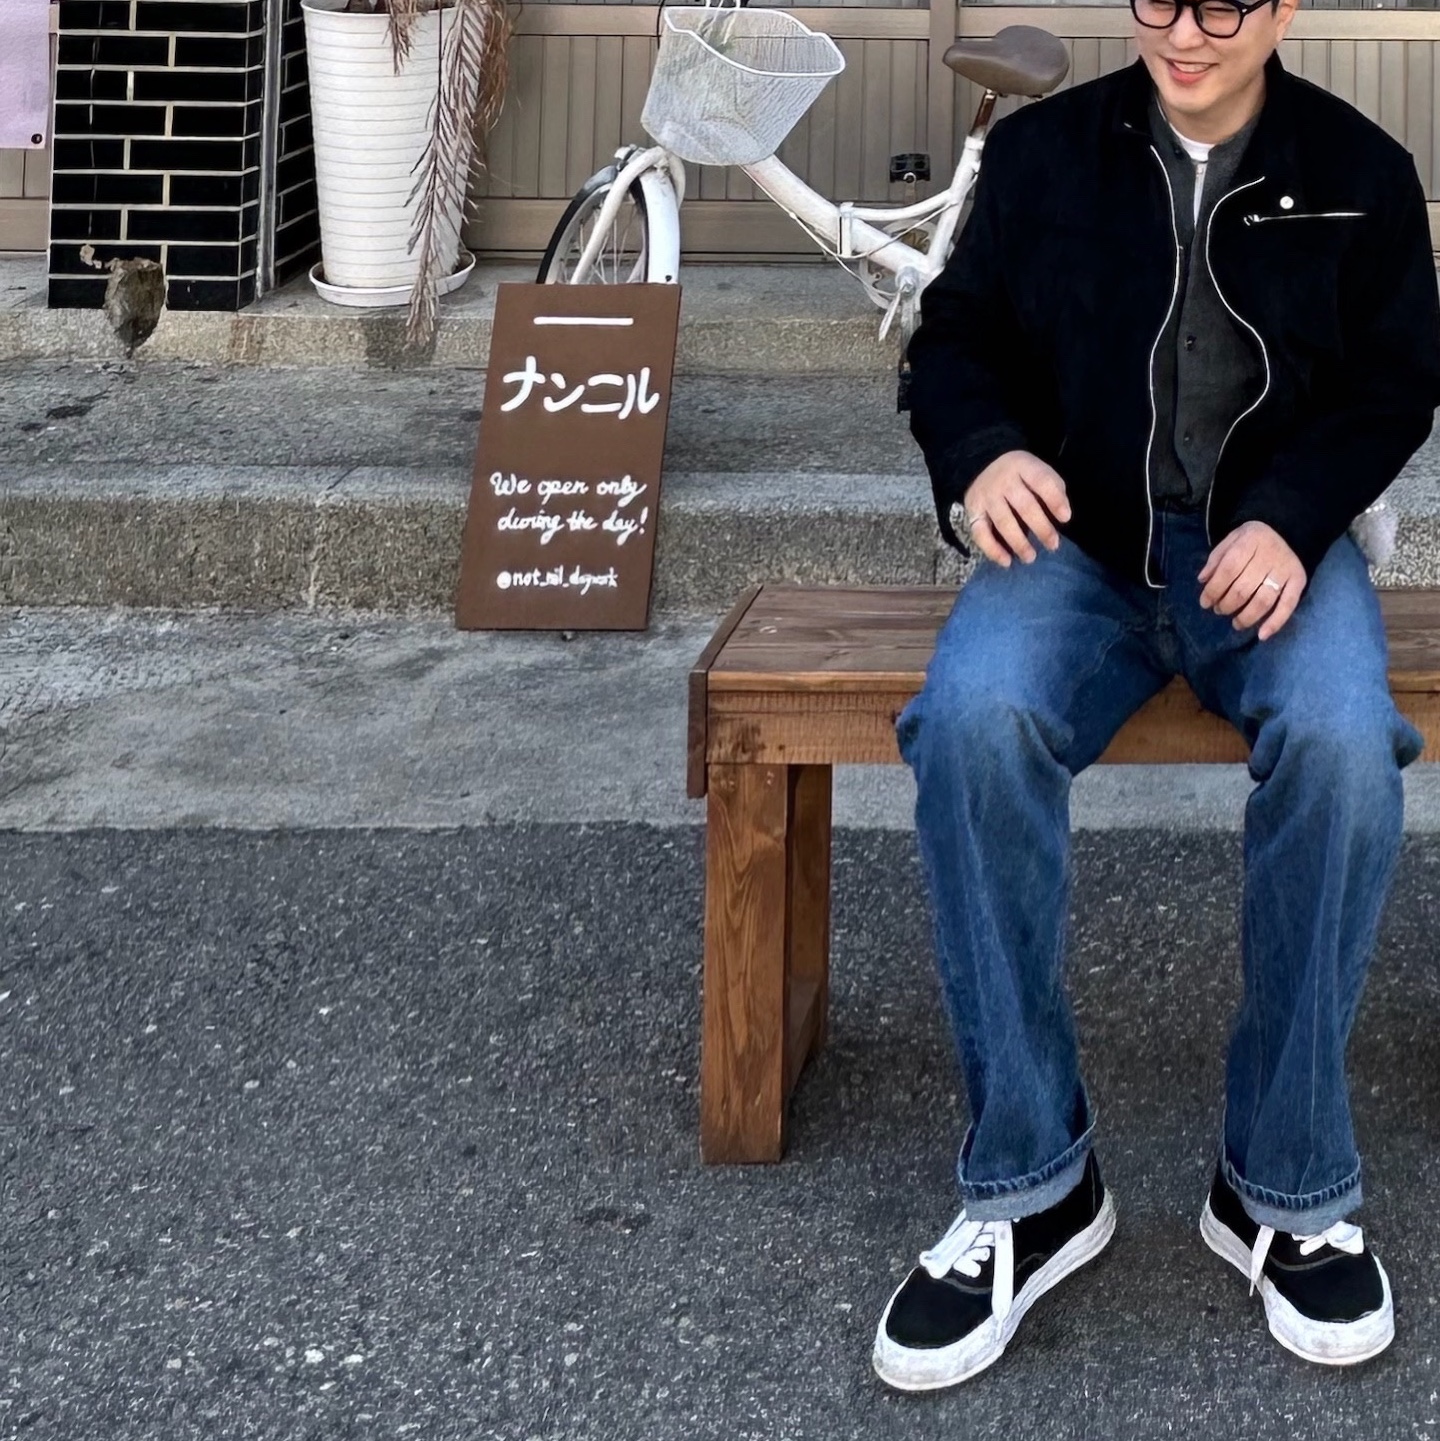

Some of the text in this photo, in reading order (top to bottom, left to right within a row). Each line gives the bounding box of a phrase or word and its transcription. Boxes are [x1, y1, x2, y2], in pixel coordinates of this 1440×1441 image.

[501, 355, 660, 420] ナンニル
[490, 472, 647, 508] We open only
[497, 506, 649, 546] during the day!
